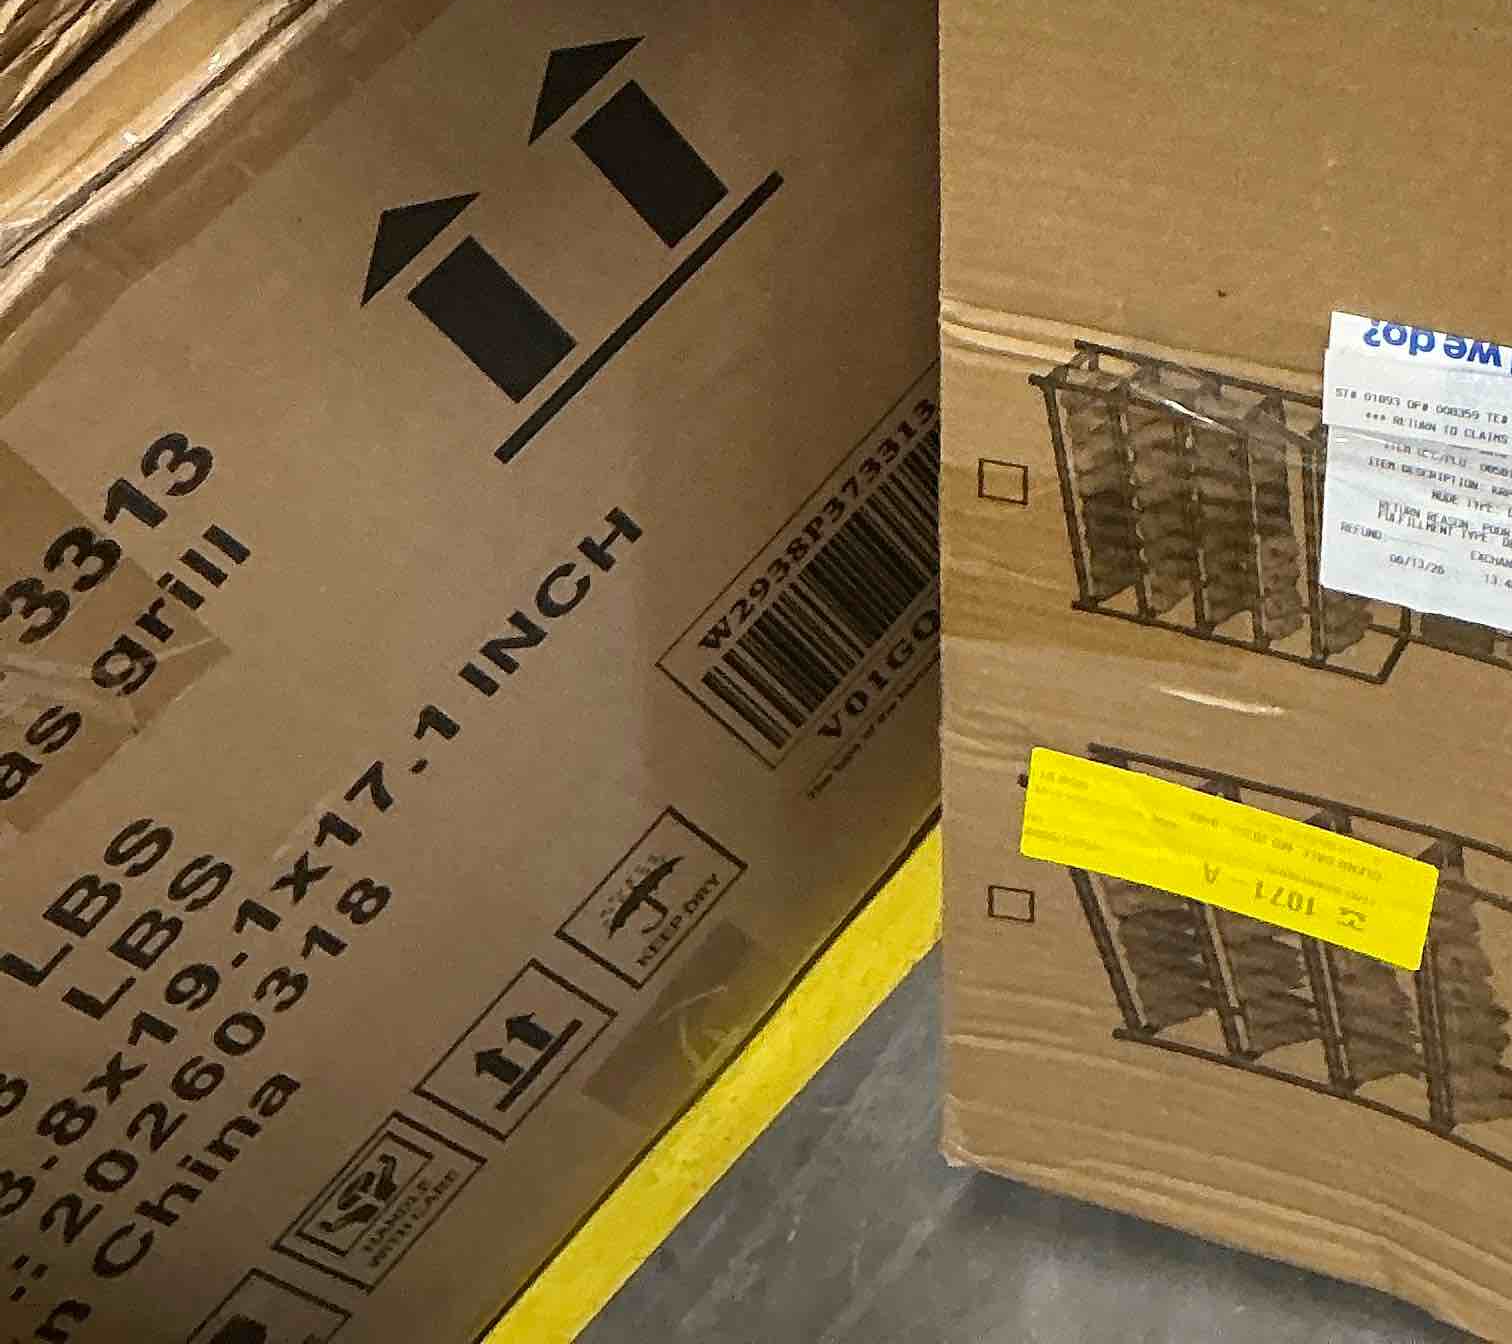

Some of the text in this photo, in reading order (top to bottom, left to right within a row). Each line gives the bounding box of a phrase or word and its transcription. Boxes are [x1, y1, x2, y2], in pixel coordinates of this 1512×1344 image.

[1362, 319, 1436, 356] do?
[1443, 334, 1503, 368] we
[1462, 426, 1510, 445] CLAIMS
[89, 523, 251, 699] grill
[458, 505, 645, 698] INCH
[0, 816, 175, 991] LBS
[61, 852, 236, 1022] LBS
[1252, 878, 1319, 918] 1071
[38, 876, 395, 1246] 20260318
[91, 1071, 303, 1280] China
